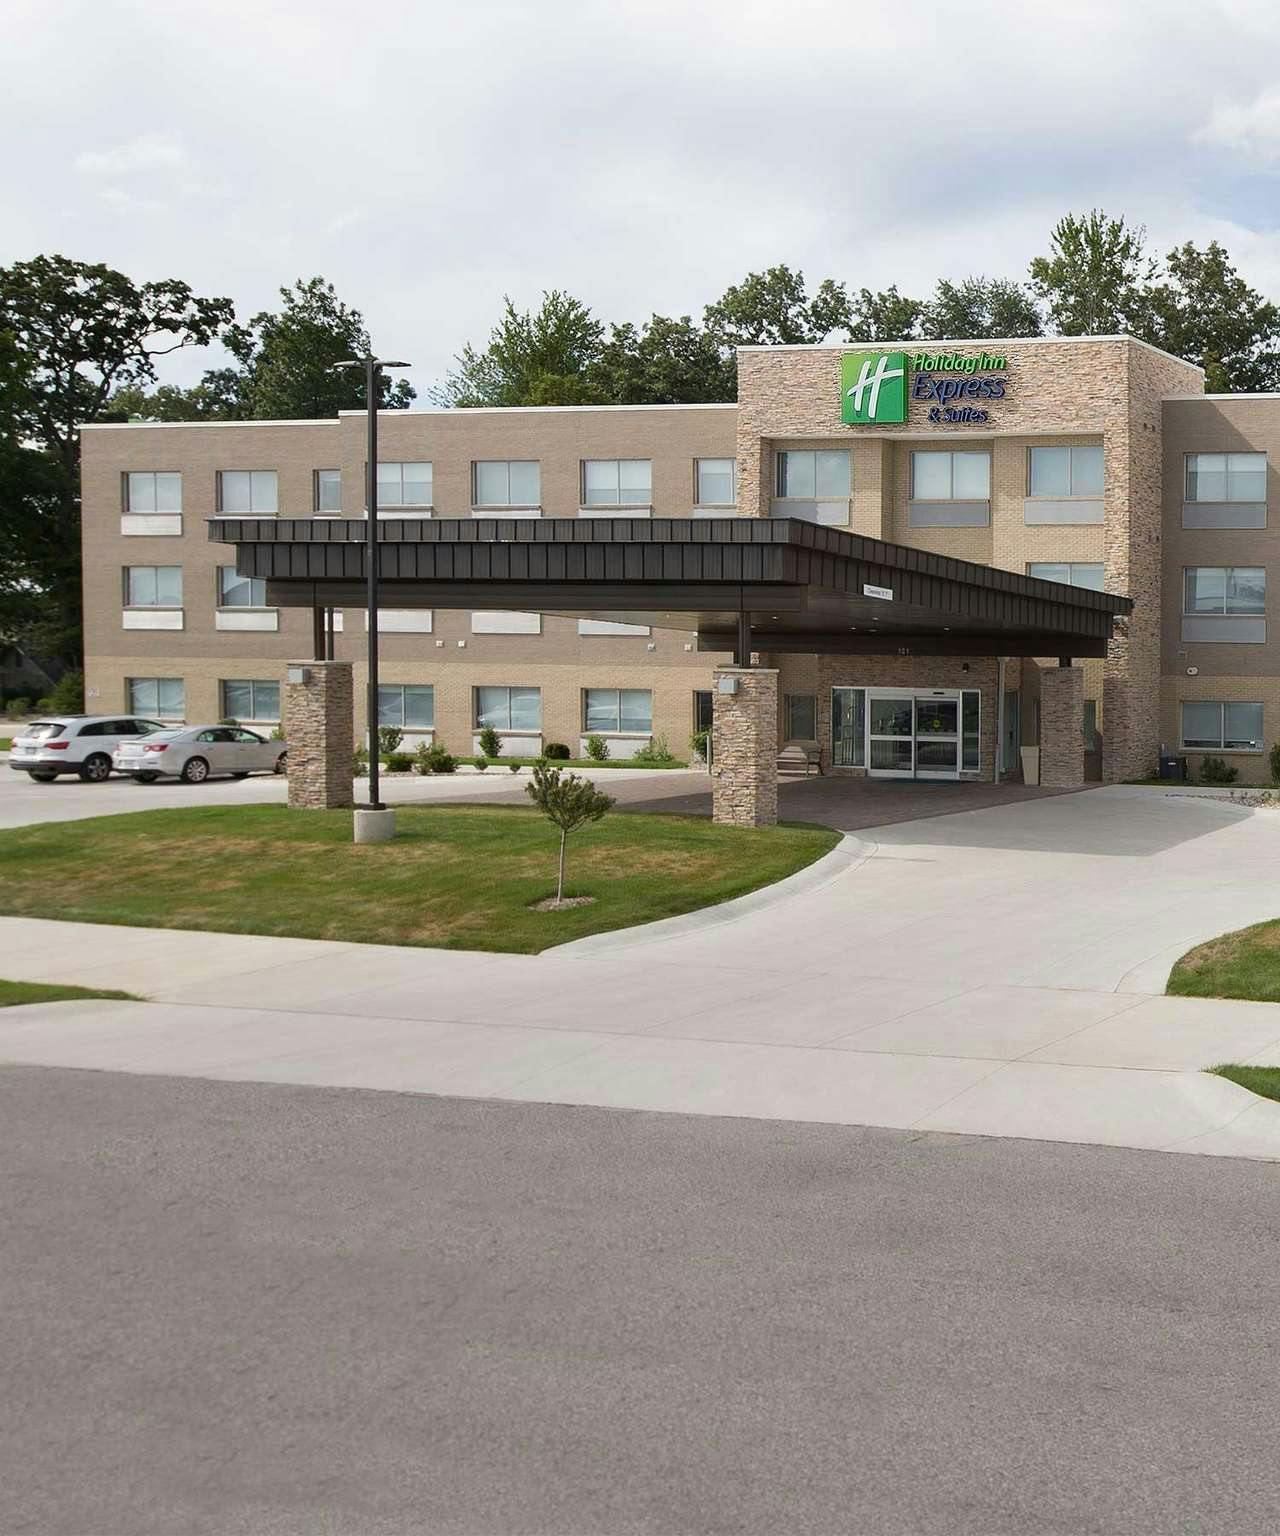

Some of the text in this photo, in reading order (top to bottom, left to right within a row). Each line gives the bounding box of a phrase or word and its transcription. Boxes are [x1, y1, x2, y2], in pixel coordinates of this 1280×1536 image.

[913, 352, 1006, 374] Holiday Inn
[912, 372, 1007, 405] Express
[928, 407, 988, 422] & Suites
